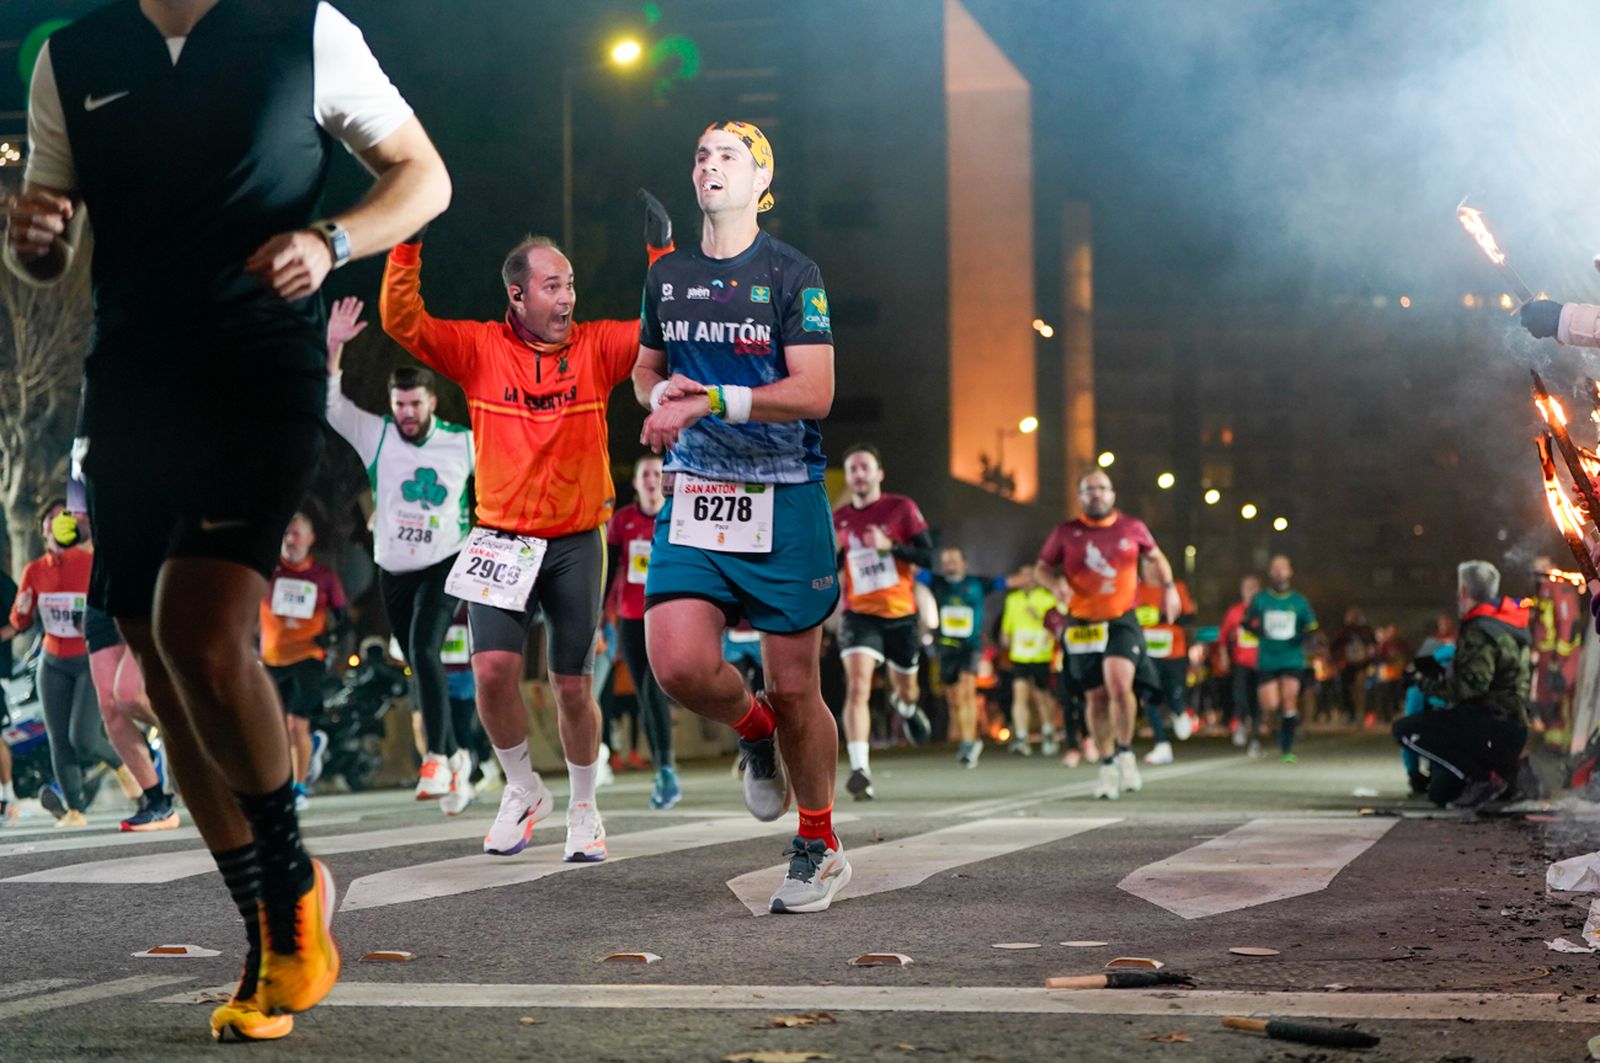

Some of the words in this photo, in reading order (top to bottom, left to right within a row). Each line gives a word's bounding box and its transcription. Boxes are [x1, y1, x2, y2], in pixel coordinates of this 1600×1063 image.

[695, 318, 770, 344] ANTÓN
[685, 484, 703, 494] SAN
[694, 496, 752, 522] 6278
[398, 526, 432, 543] 2238
